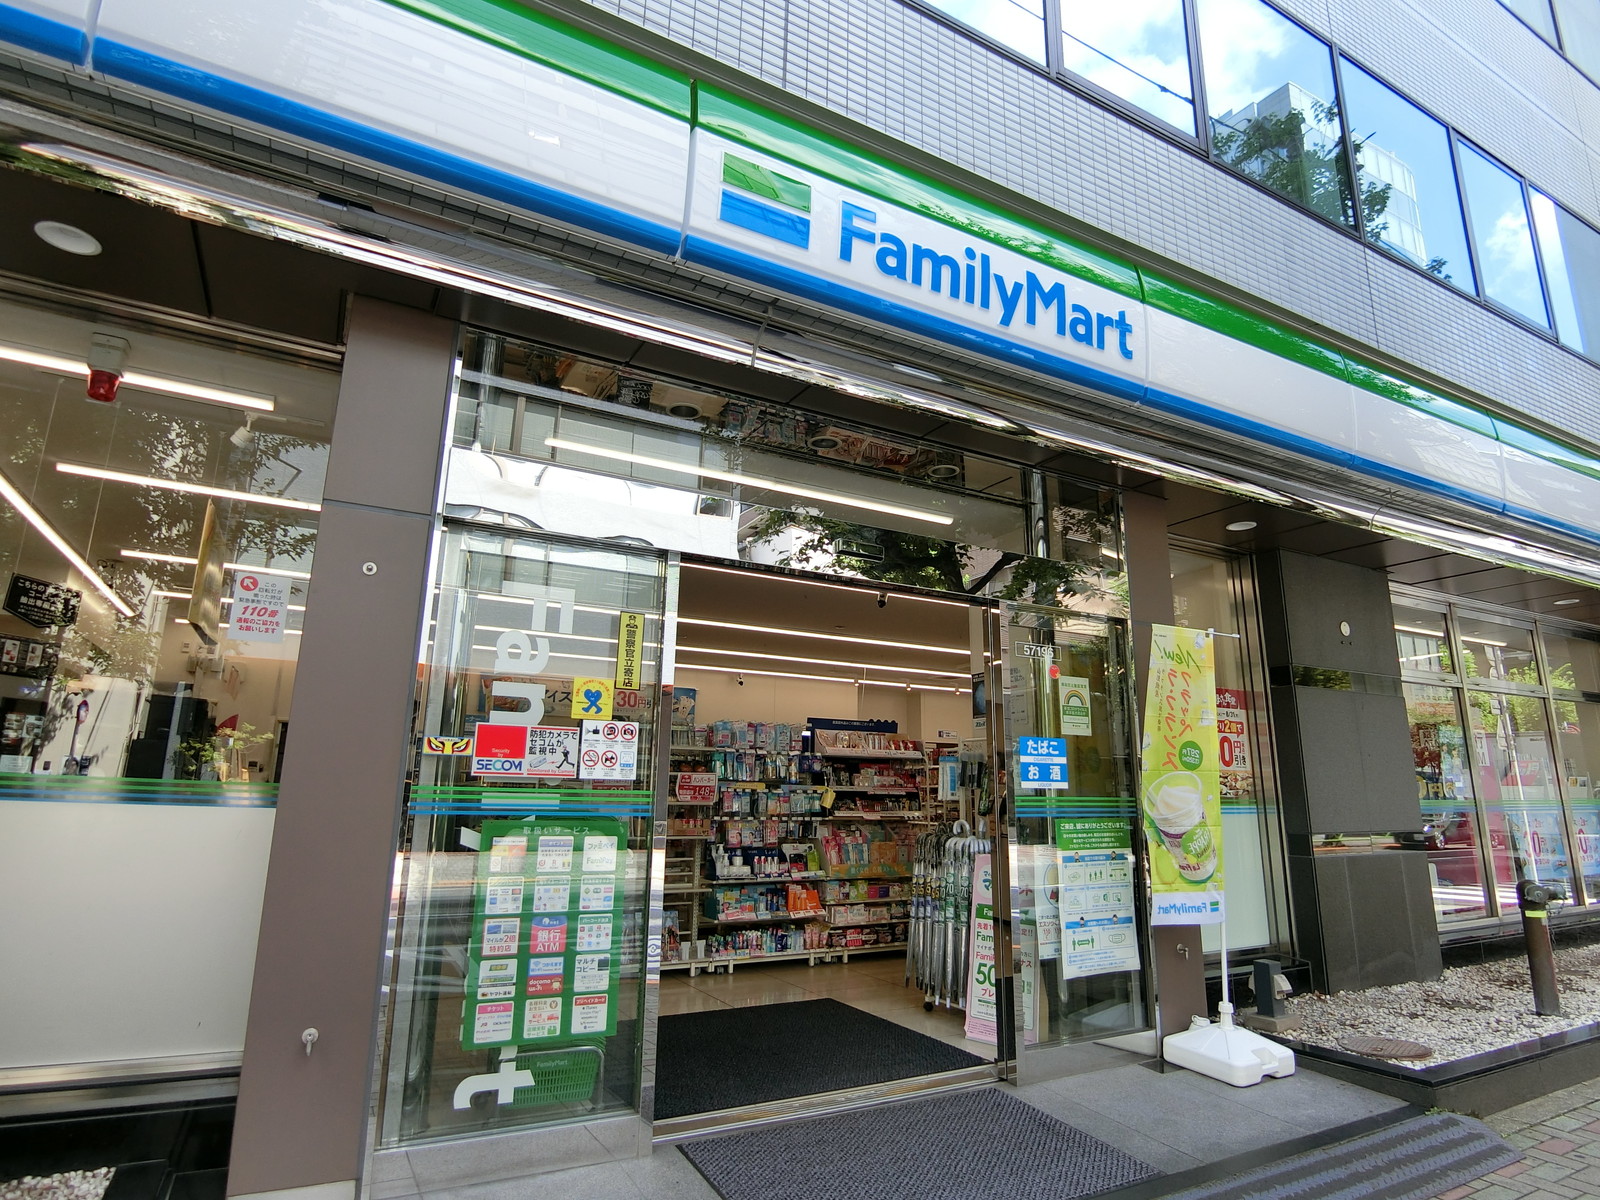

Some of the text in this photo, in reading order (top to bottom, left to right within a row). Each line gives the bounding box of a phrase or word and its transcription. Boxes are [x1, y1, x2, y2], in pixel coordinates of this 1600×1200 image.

[840, 200, 1134, 359] FamilyMart
[241, 605, 279, 618] 110番
[236, 617, 280, 627] 通報のご協力を
[238, 625, 277, 634] お願いします
[1023, 645, 1055, 658] 57196
[622, 629, 636, 688] 警察官立寄店
[529, 730, 577, 740] 防犯カメラで
[529, 739, 563, 748] セコムが
[1026, 739, 1060, 754] たばこ
[528, 747, 557, 755] 監視中
[476, 759, 523, 771] SECOM
[523, 826, 590, 835] 取扱いサービス
[588, 841, 615, 850] ファミペイ
[537, 929, 561, 942] 銀行
[536, 942, 560, 952] ATM
[577, 957, 595, 965] マルチ
